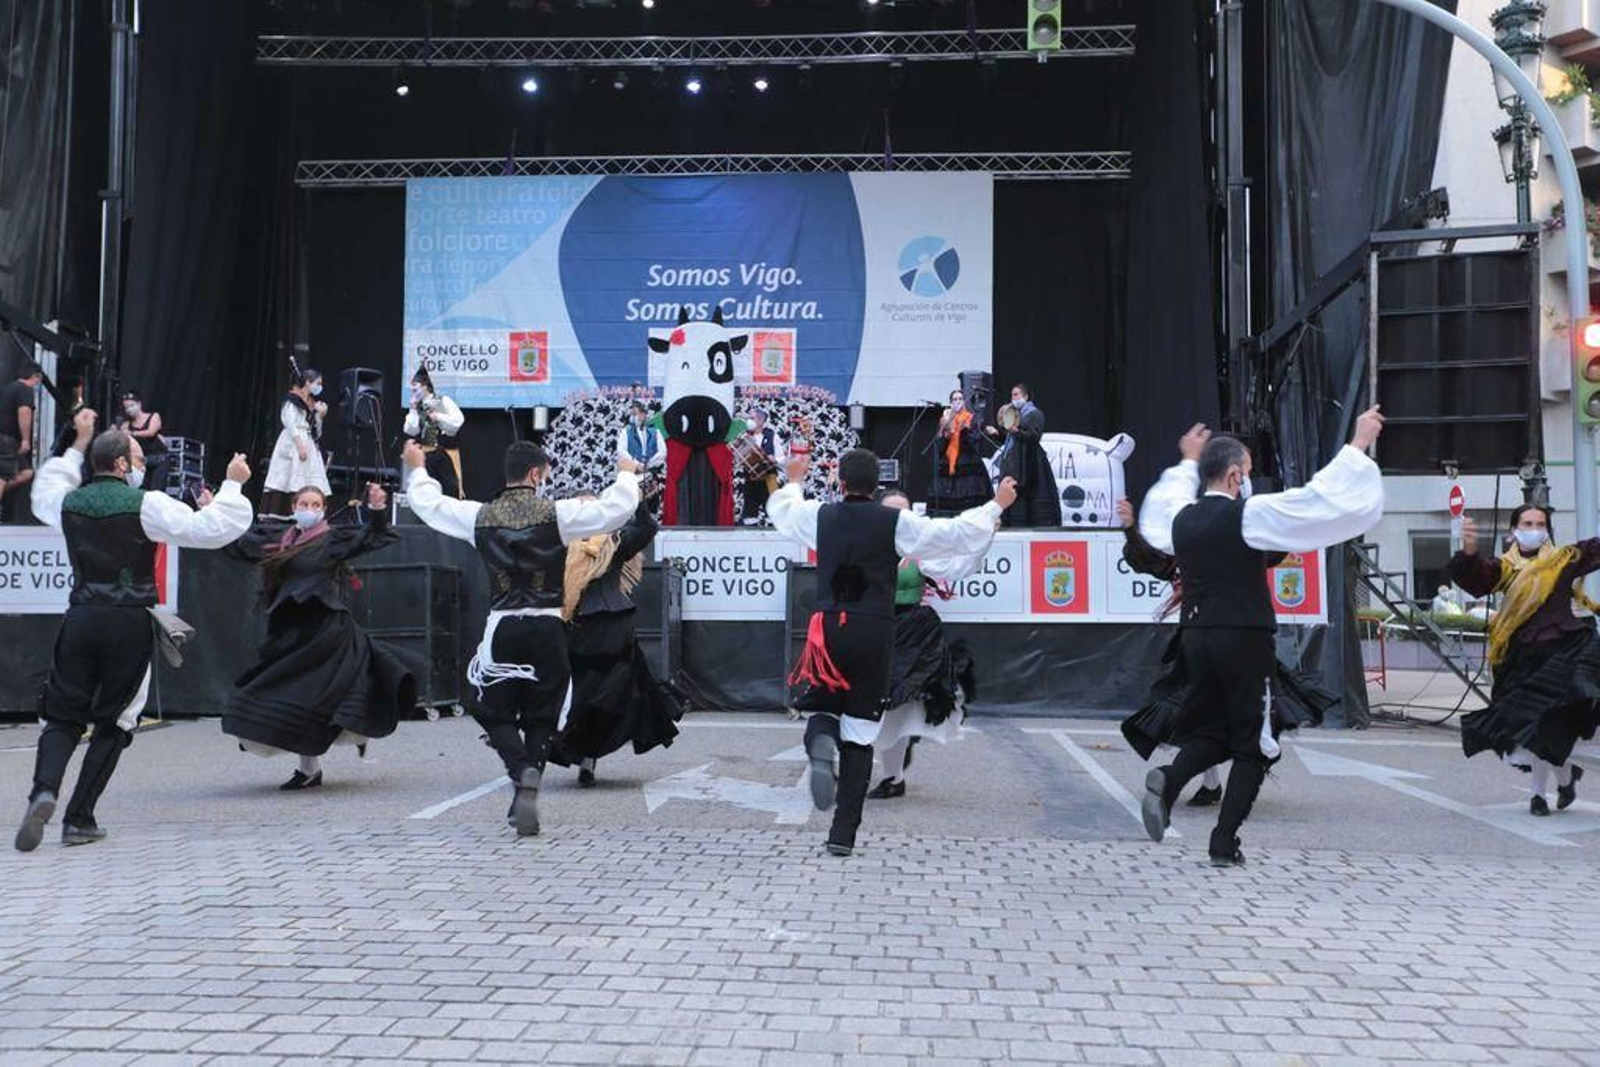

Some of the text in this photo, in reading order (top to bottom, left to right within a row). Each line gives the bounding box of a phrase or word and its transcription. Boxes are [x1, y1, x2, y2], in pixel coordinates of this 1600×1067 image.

[477, 207, 546, 225] teatro
[647, 262, 803, 292] Somos Vigo.
[719, 295, 824, 320] Cultura.
[416, 343, 499, 357] CONCELLO
[426, 358, 490, 372] DE VIGO
[686, 579, 775, 596] DE VIGO
[1132, 580, 1161, 598] DE
